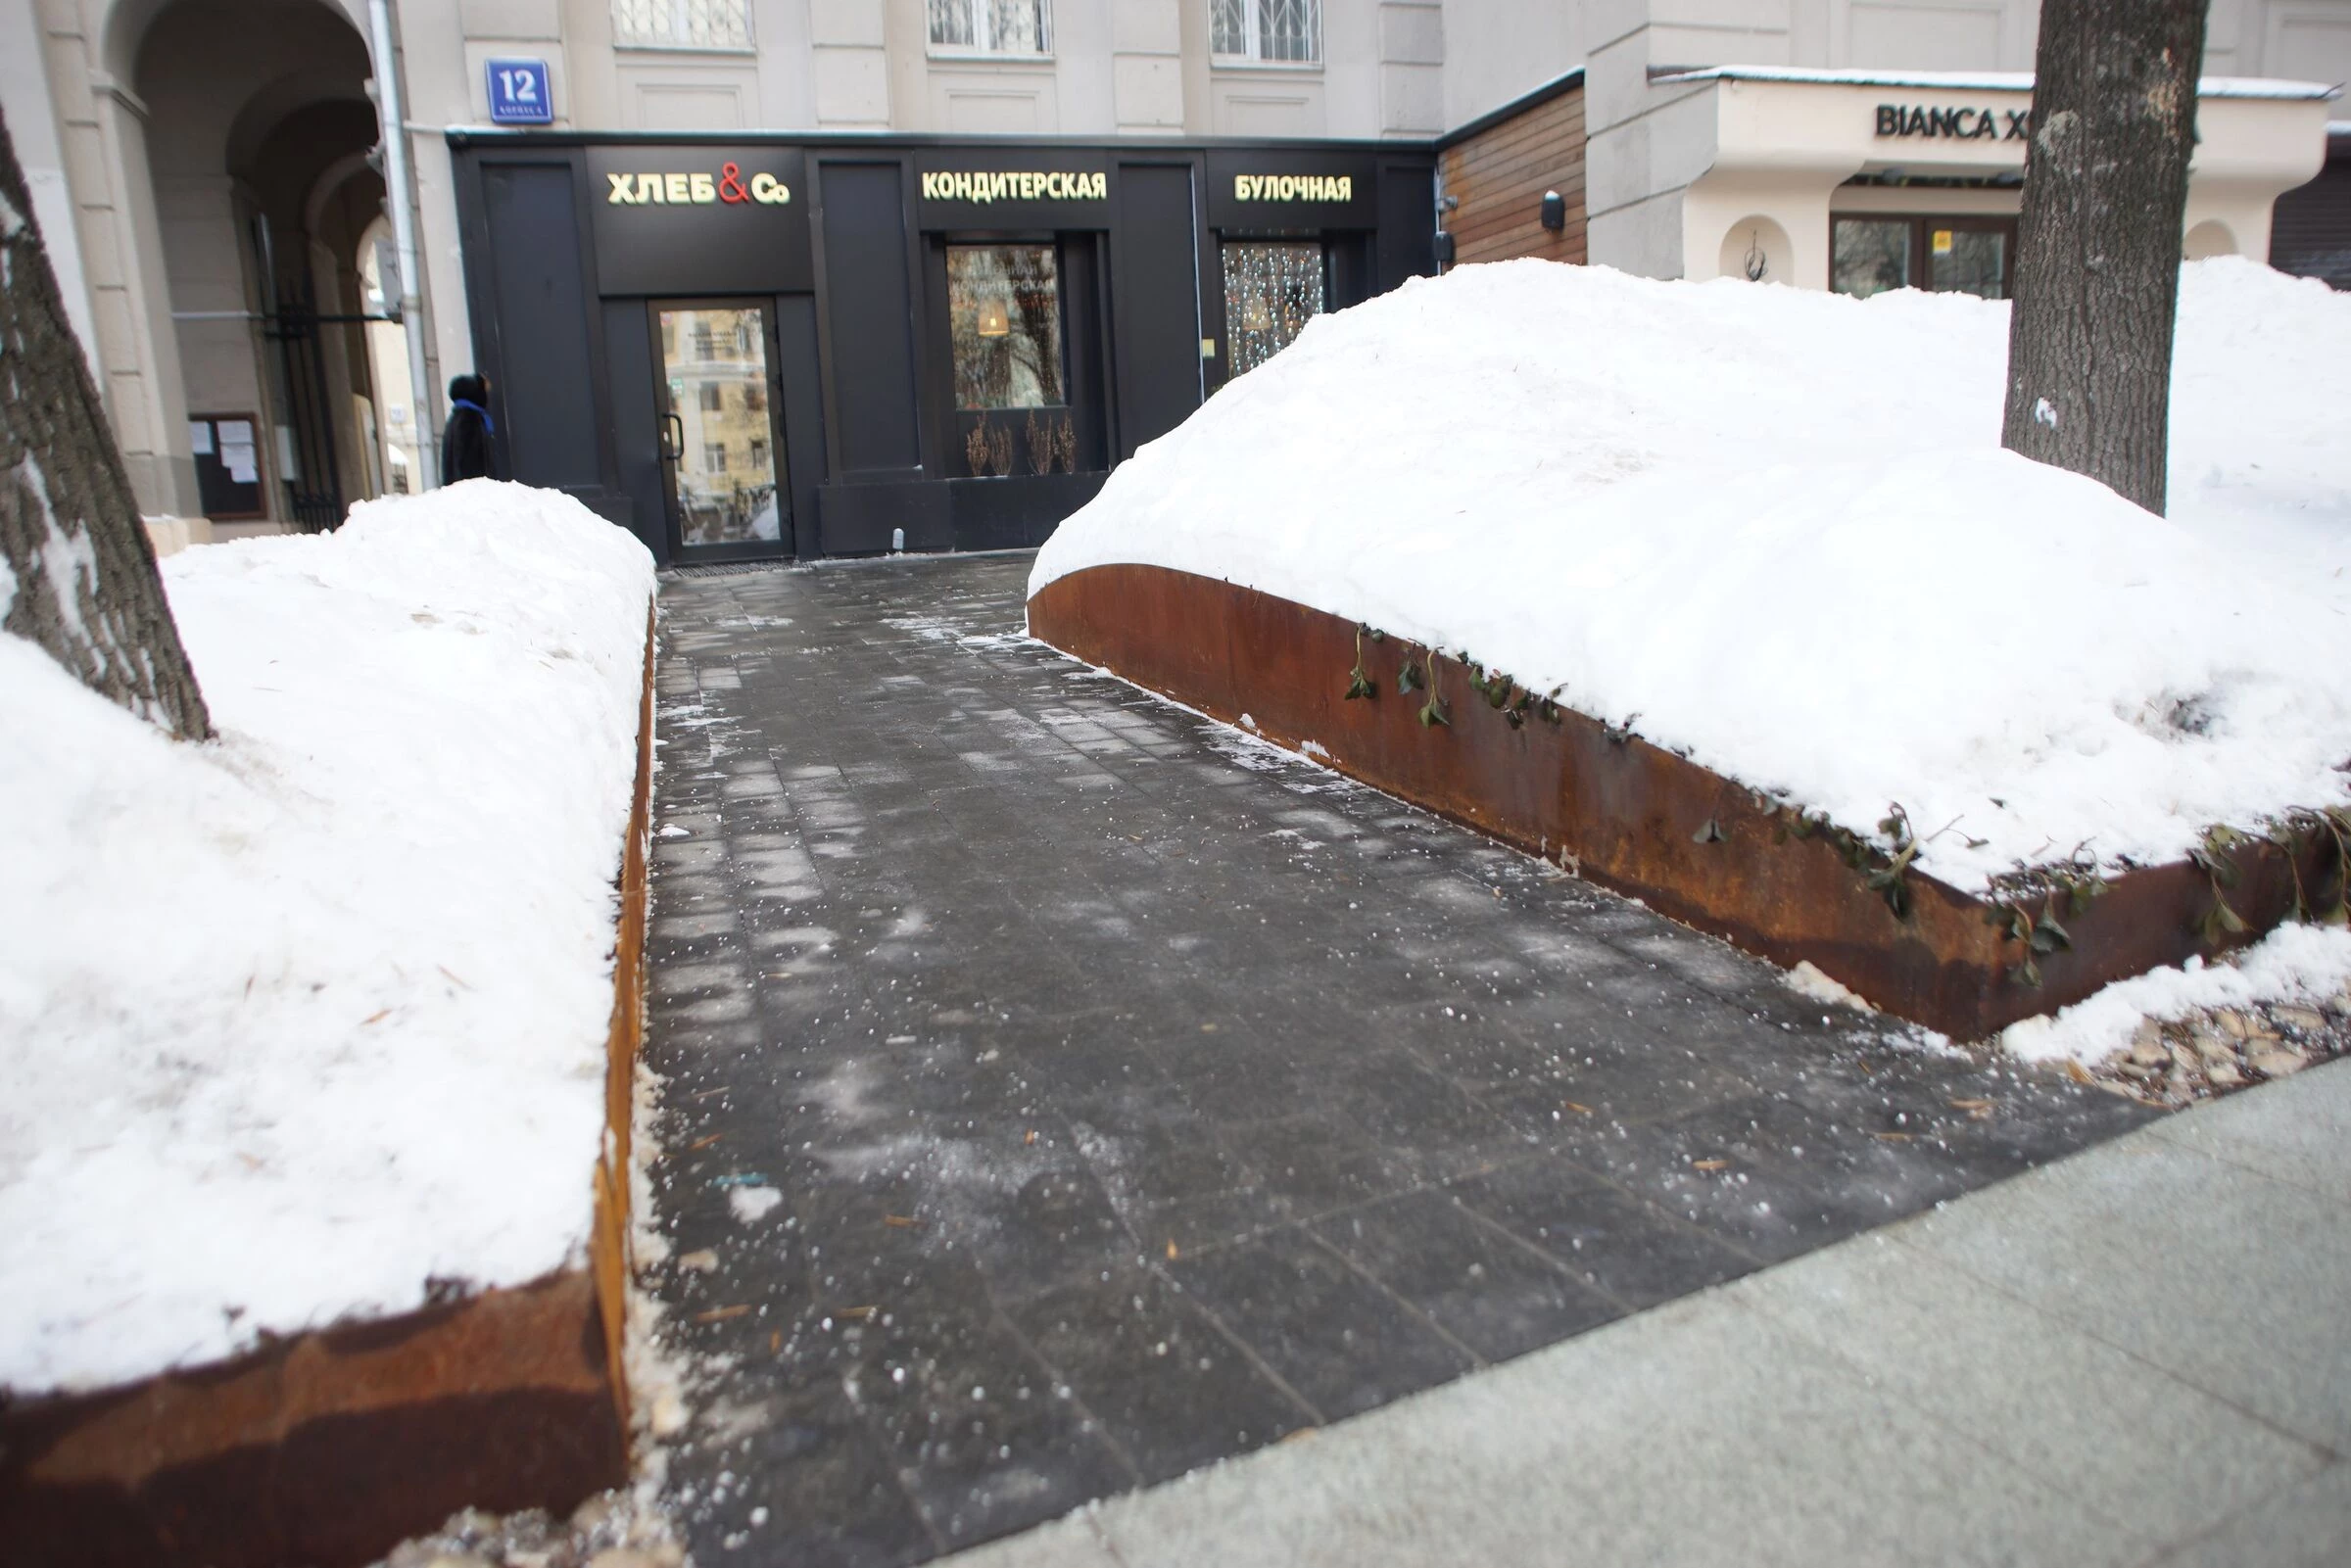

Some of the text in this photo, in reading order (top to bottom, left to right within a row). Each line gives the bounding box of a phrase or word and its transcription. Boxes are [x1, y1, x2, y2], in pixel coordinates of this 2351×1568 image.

[499, 69, 538, 104] 12
[1876, 104, 1998, 139] BIANCA
[922, 171, 1108, 204] КОНДИТЕРСКАЯ
[1234, 174, 1352, 202] БУЛОЧНАЯ
